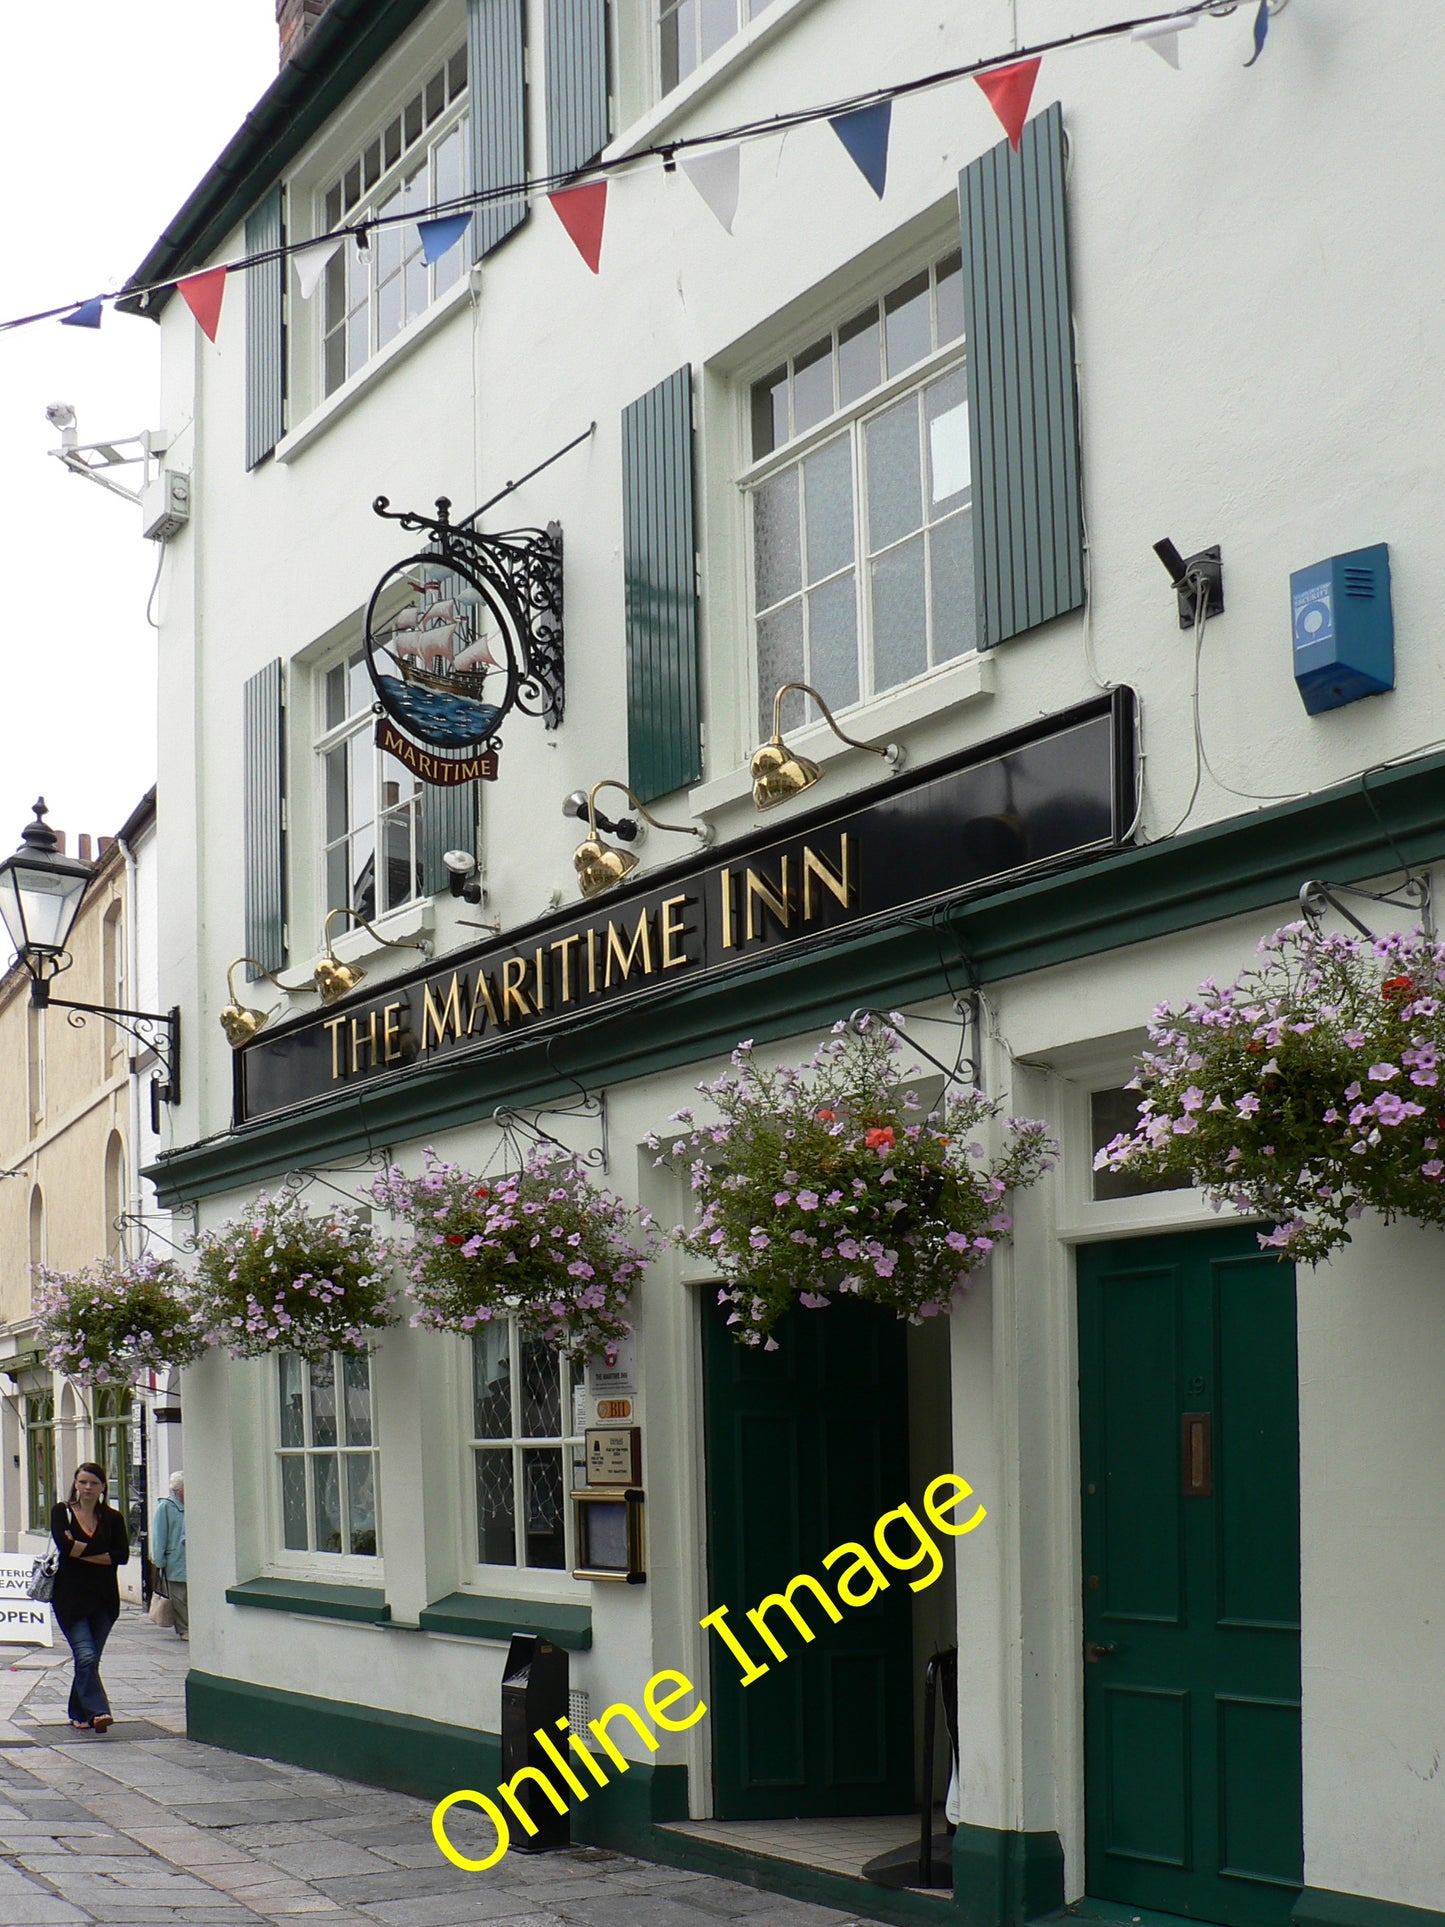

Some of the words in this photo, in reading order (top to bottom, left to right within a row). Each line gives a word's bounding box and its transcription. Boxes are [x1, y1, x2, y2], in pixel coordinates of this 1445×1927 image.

[385, 730, 491, 782] MARITIME
[323, 1002, 402, 1080] THE
[421, 894, 690, 1051] MARITIME
[721, 832, 851, 949] INN
